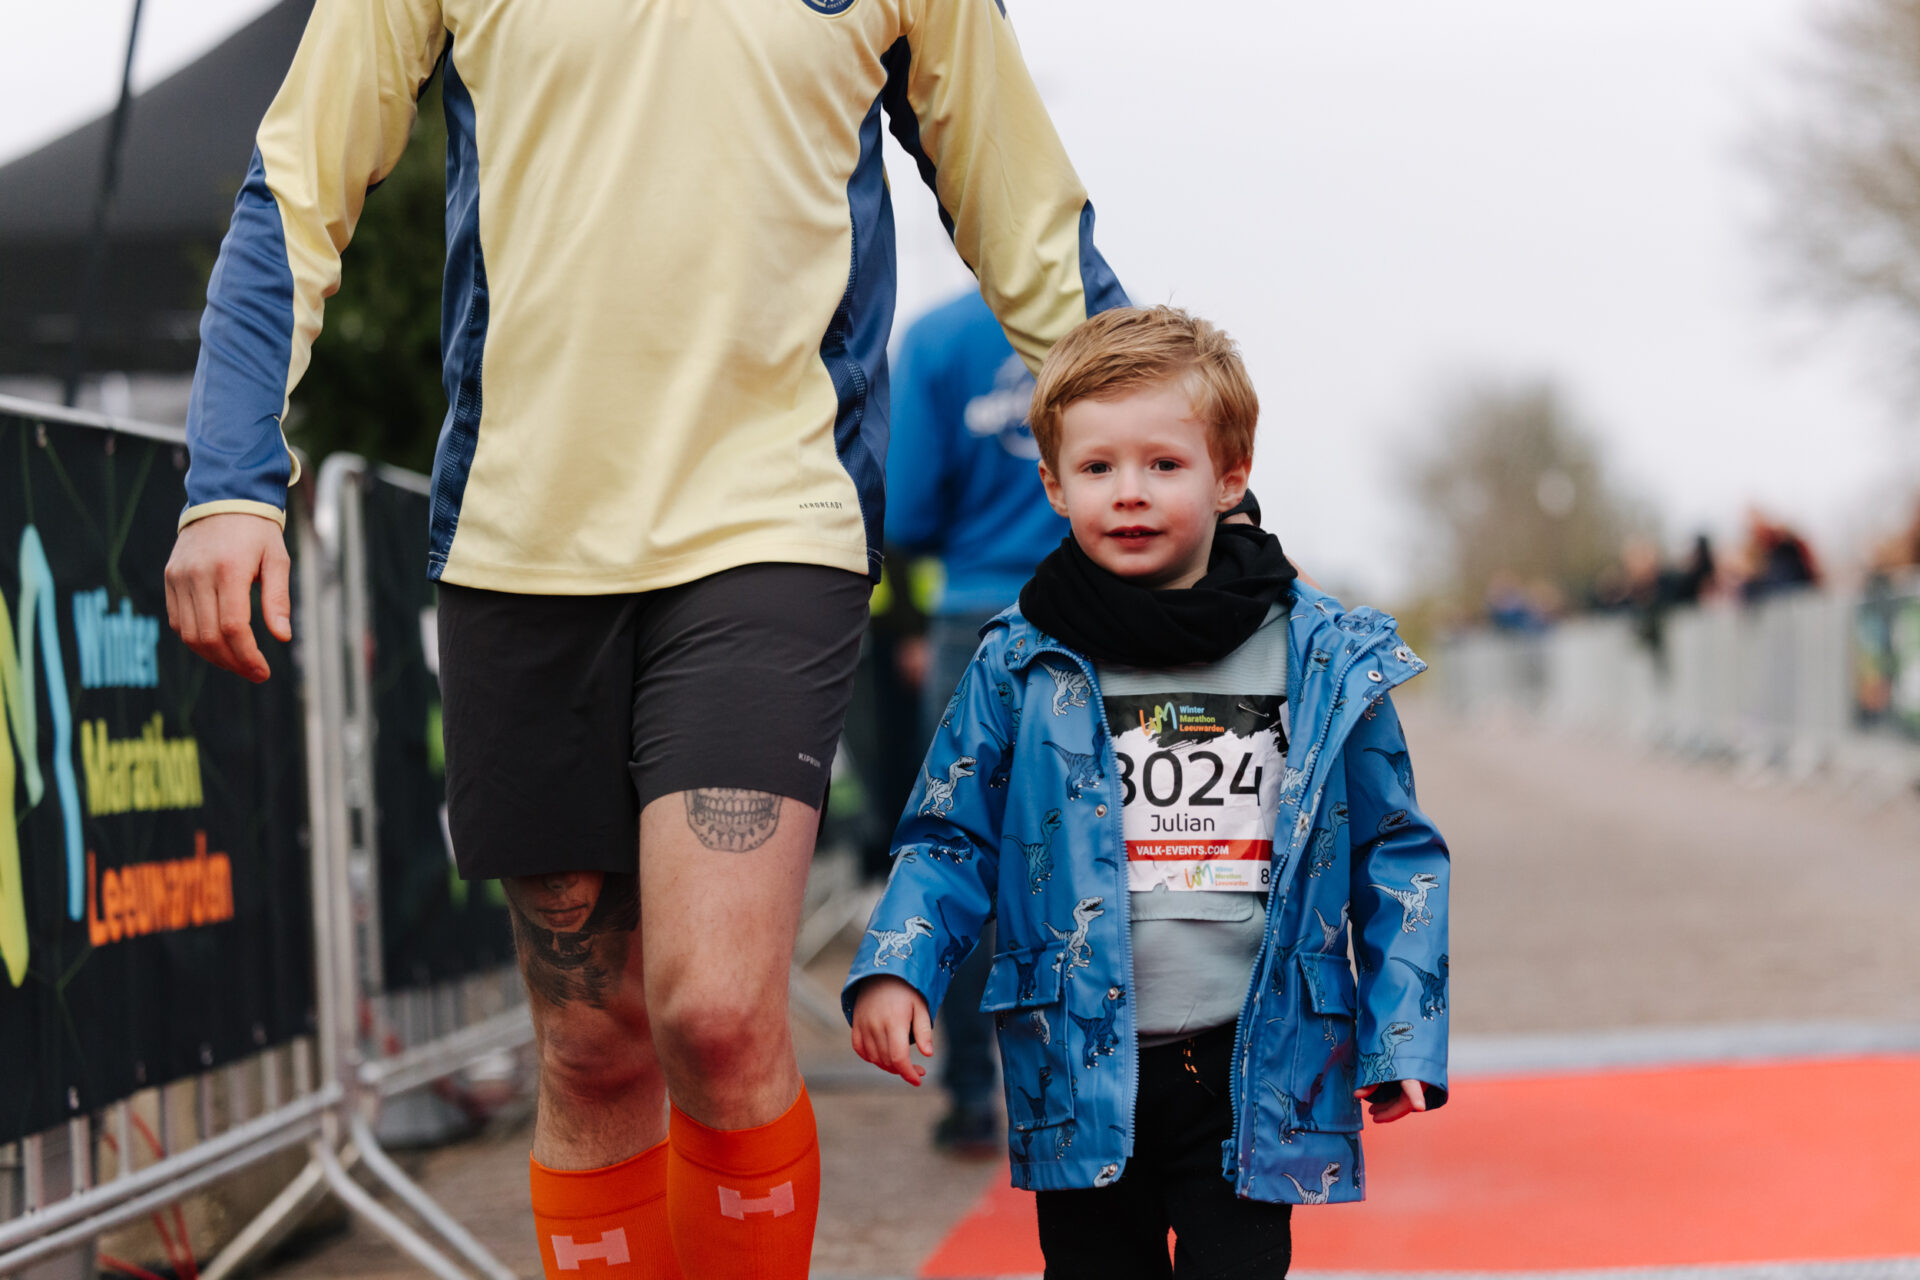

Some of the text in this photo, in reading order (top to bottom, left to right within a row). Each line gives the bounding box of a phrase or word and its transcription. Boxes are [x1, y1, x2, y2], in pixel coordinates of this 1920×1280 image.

[73, 587, 160, 688] Winter
[1179, 705, 1205, 714] Winter
[1179, 715, 1216, 723] Marathon
[1179, 724, 1225, 733] Leeuwarden
[81, 712, 203, 816] Marathon
[1150, 813, 1215, 832] Julian
[1136, 845, 1229, 856] VALK-EVENTS.COM
[1260, 868, 1270, 884] 8
[87, 830, 234, 947] Leeuwarden
